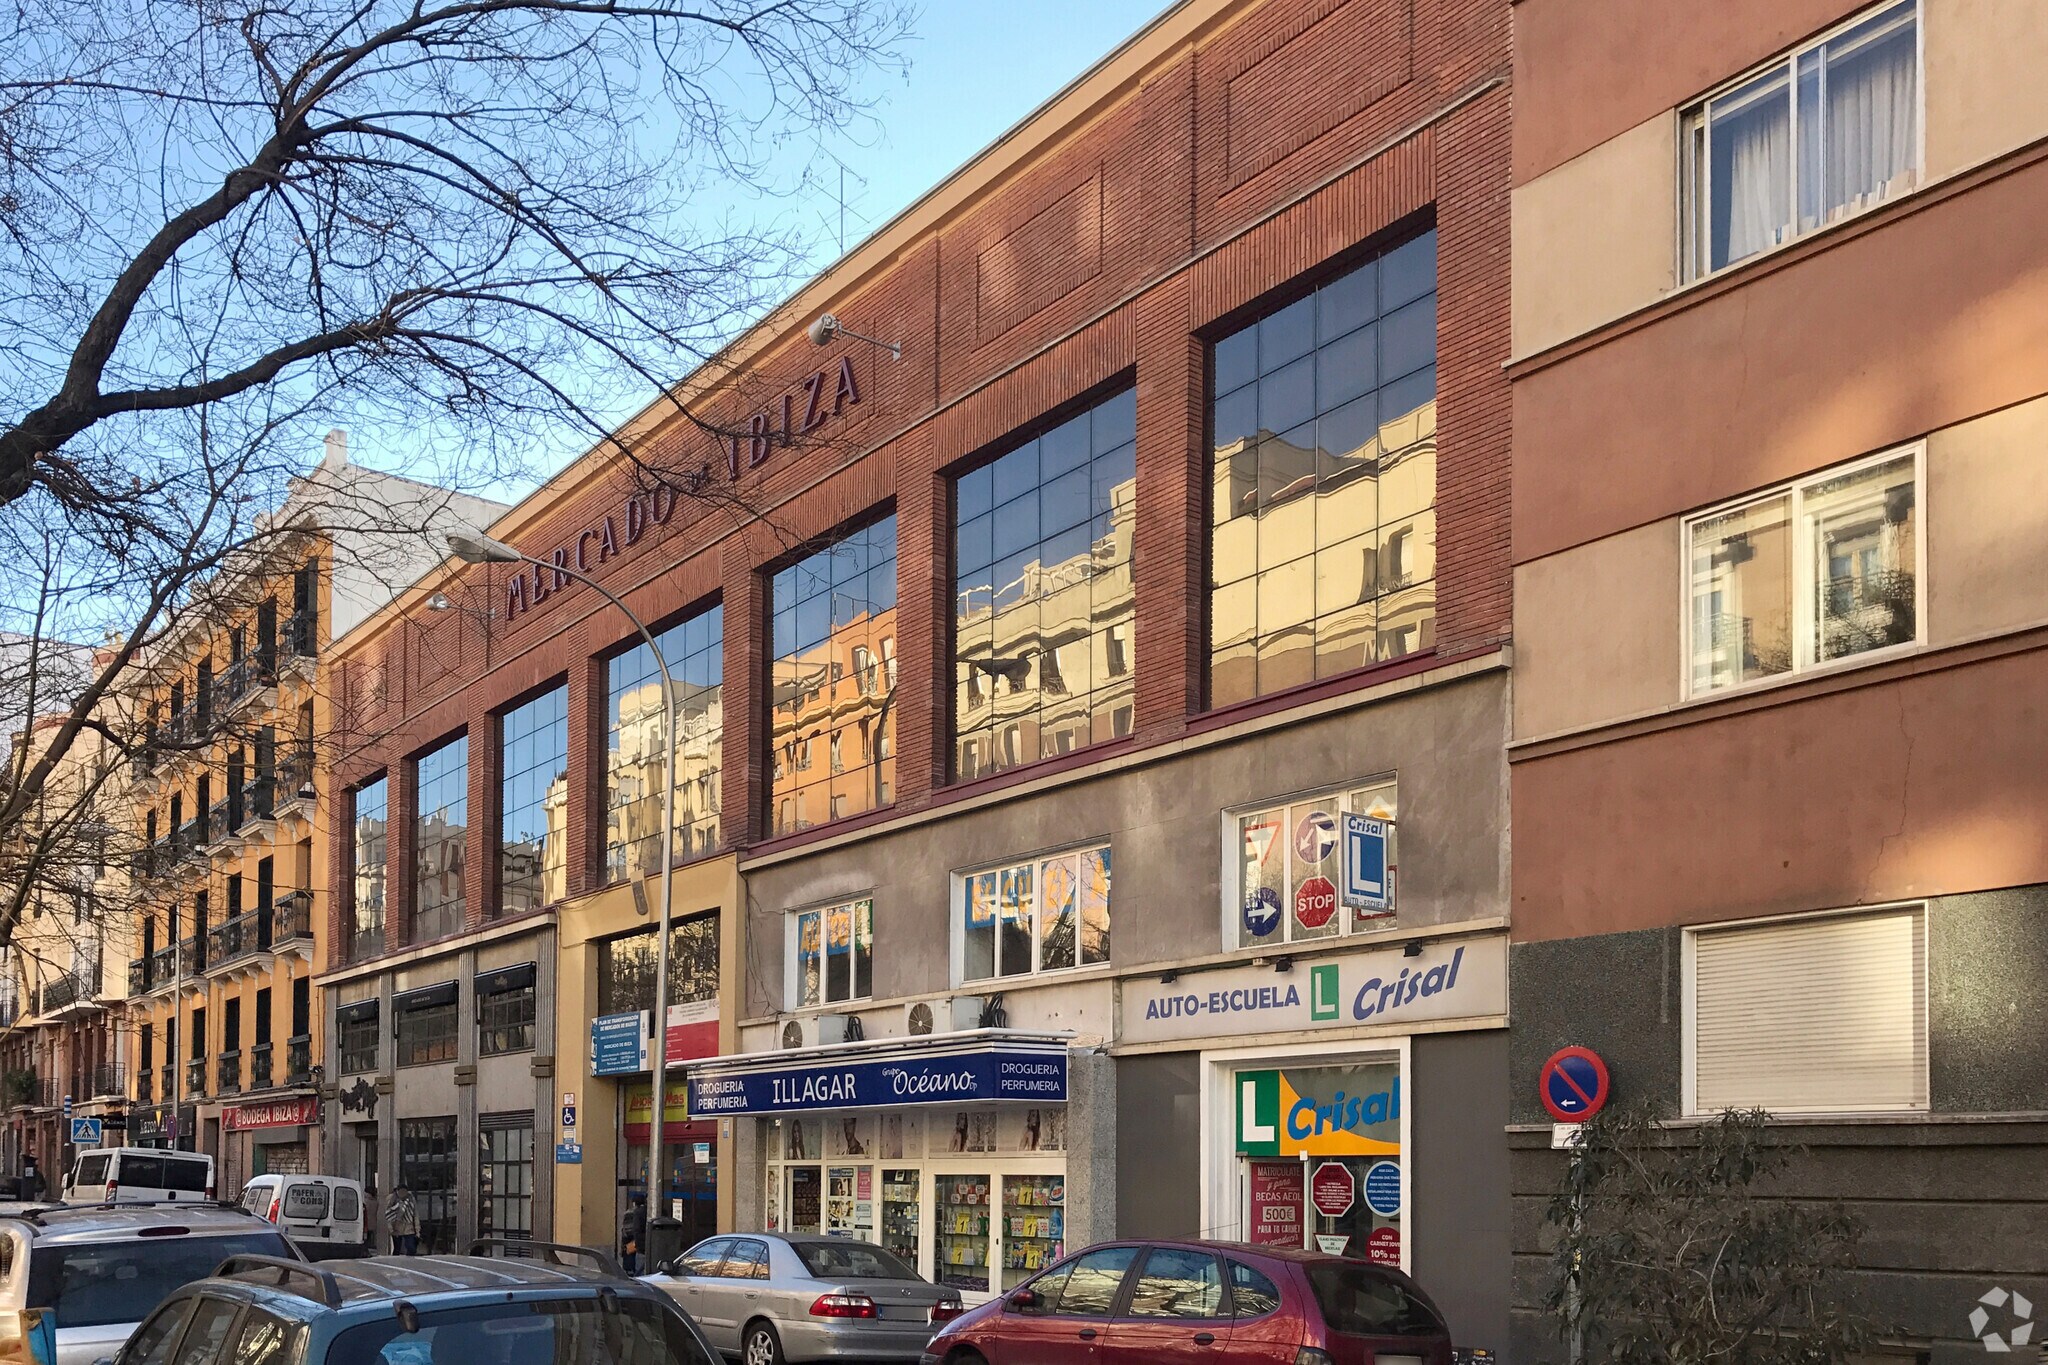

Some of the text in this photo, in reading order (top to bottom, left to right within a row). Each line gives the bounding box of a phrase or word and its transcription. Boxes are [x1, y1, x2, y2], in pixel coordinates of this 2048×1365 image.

[506, 482, 677, 621] MERCADO
[727, 356, 859, 481] IBIZA
[1348, 816, 1383, 835] Crisal
[1352, 835, 1380, 894] L
[1297, 894, 1334, 912] STOP
[1146, 946, 1465, 1021] AUTO-ESCUELA L Crisal
[1001, 1062, 1060, 1075] DROGUERIA
[698, 1080, 744, 1095] DROGUERIA
[772, 1073, 857, 1104] ILLAGAR
[882, 1067, 976, 1095] Grupo Océano
[1001, 1079, 1061, 1091] PERFUMERIA
[698, 1096, 748, 1110] PERFUMERIA
[1242, 1075, 1400, 1142] L Crisal
[242, 1104, 292, 1125] BODEGA IBIZA
[1256, 1191, 1281, 1201] BECAS
[1265, 1208, 1293, 1221] 500€
[1257, 1225, 1271, 1234] PARA
[1281, 1224, 1300, 1234] CARNET
[1370, 1249, 1388, 1258] 10%
